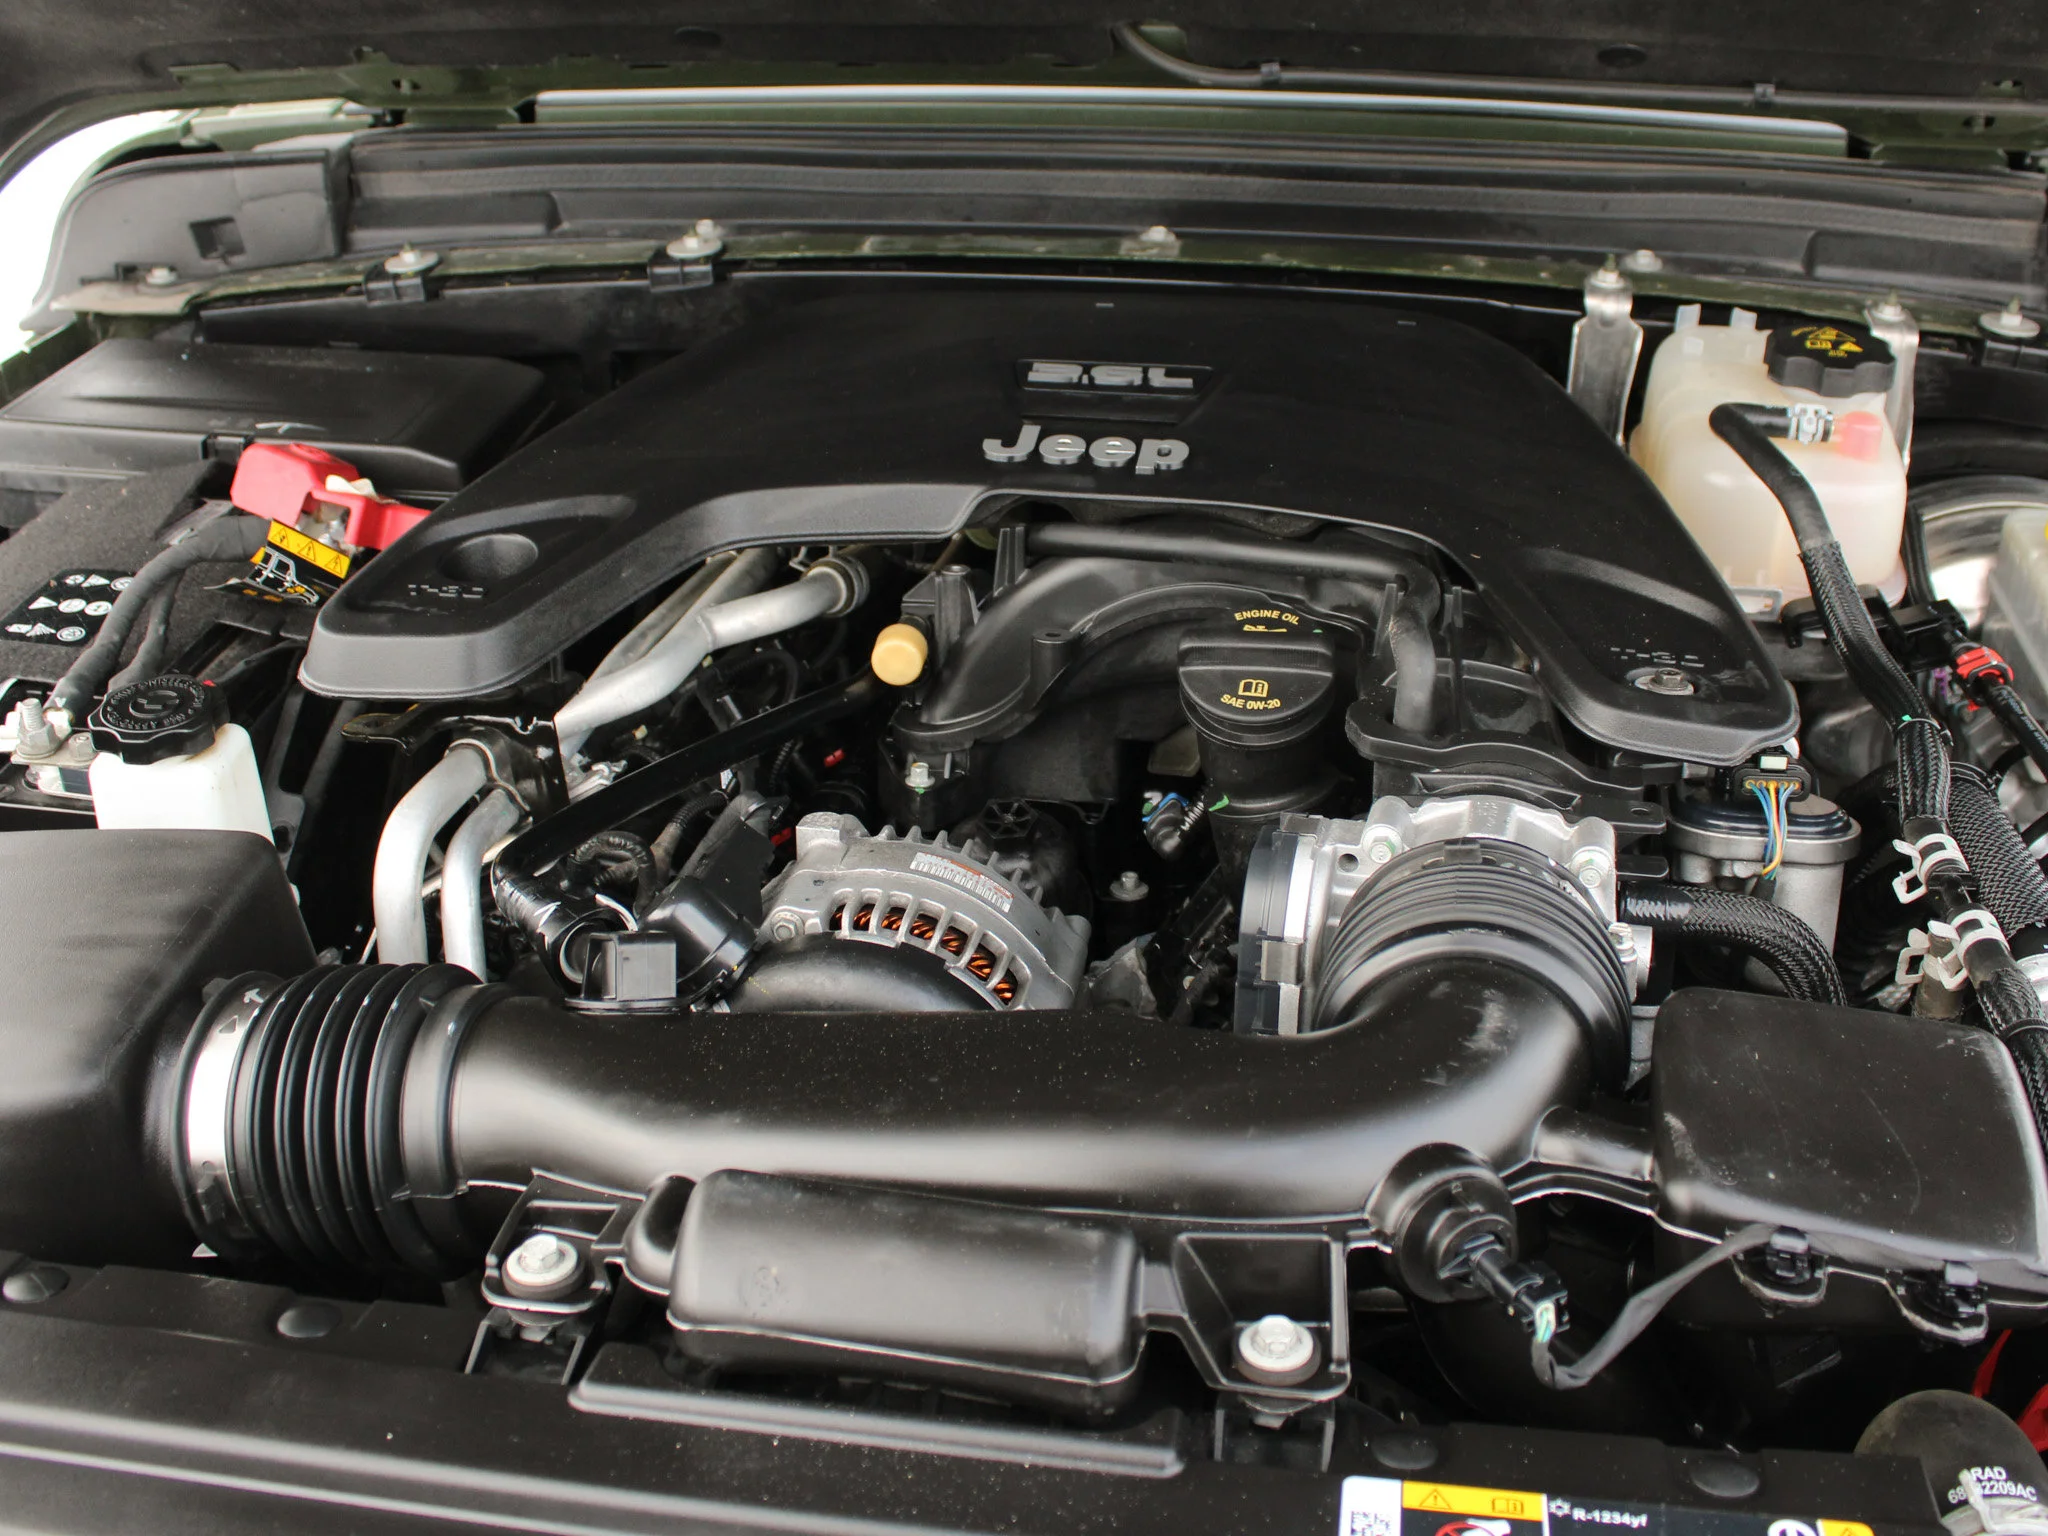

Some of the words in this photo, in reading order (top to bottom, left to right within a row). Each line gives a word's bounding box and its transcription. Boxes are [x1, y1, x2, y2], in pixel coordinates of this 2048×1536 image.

[982, 424, 1190, 475] Jeep
[1234, 609, 1280, 621] ENGINE
[1281, 613, 1300, 625] OIL
[1220, 693, 1245, 709] SAE
[1246, 698, 1281, 710] 0W-20
[1970, 1466, 2007, 1481] RAD
[1947, 1480, 2038, 1504] 682209AC
[1572, 1507, 1648, 1529] R-1234yf
